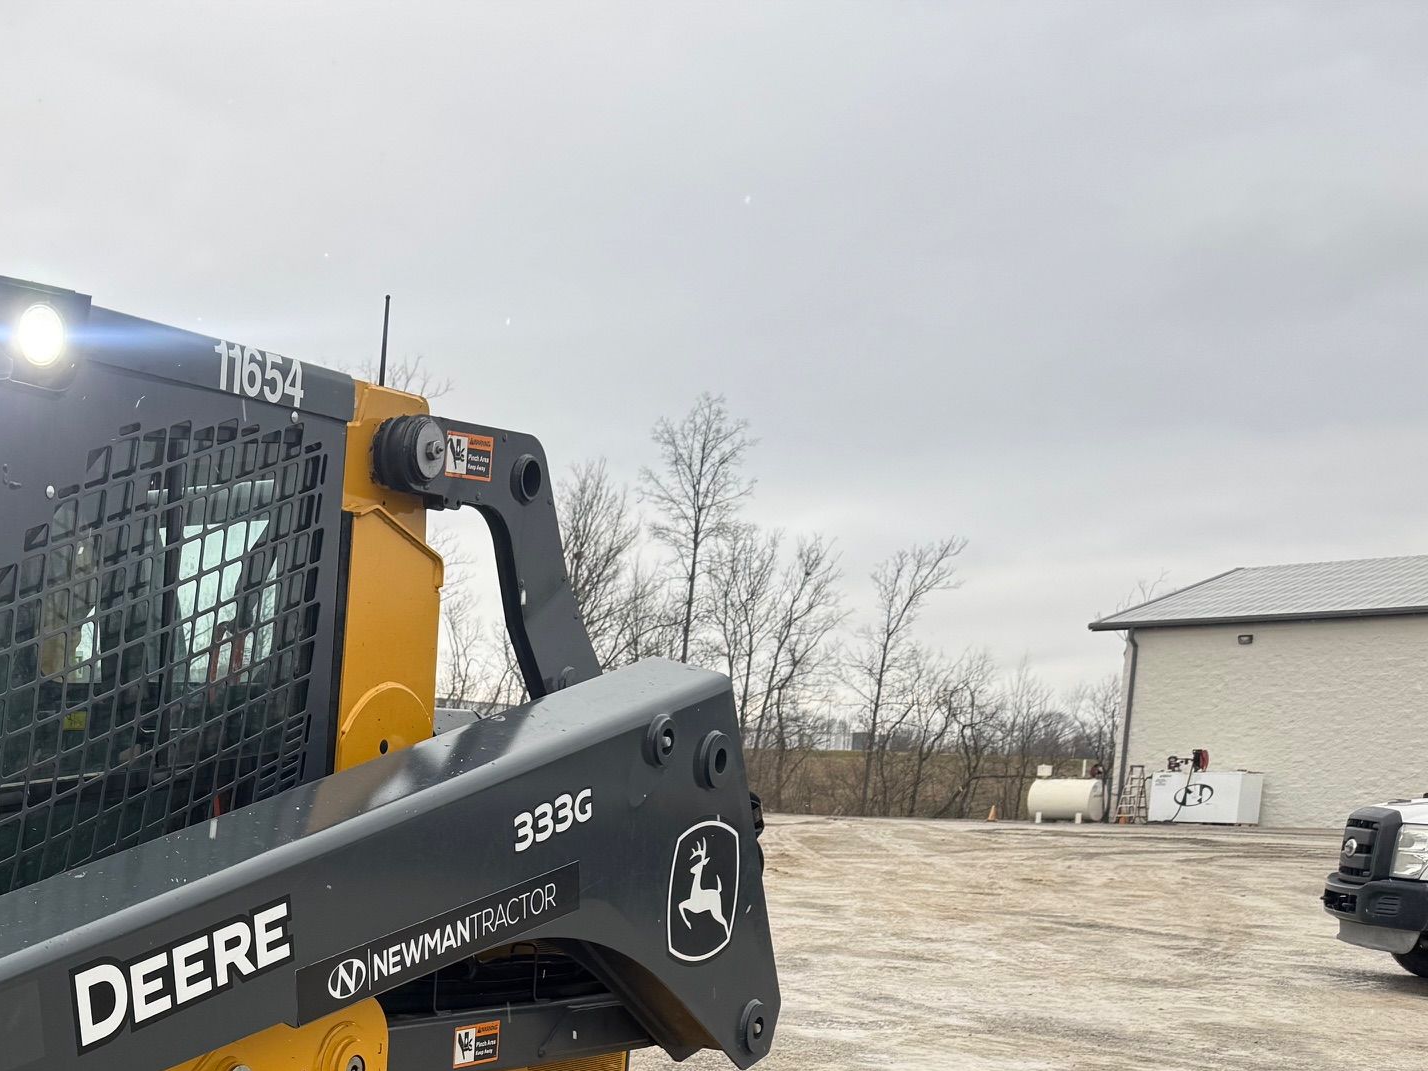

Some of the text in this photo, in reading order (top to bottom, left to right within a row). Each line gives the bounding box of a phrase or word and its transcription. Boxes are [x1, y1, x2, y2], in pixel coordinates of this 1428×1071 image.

[214, 340, 304, 408] 11654
[514, 788, 592, 852] 333G
[74, 902, 291, 1047] DEERE
